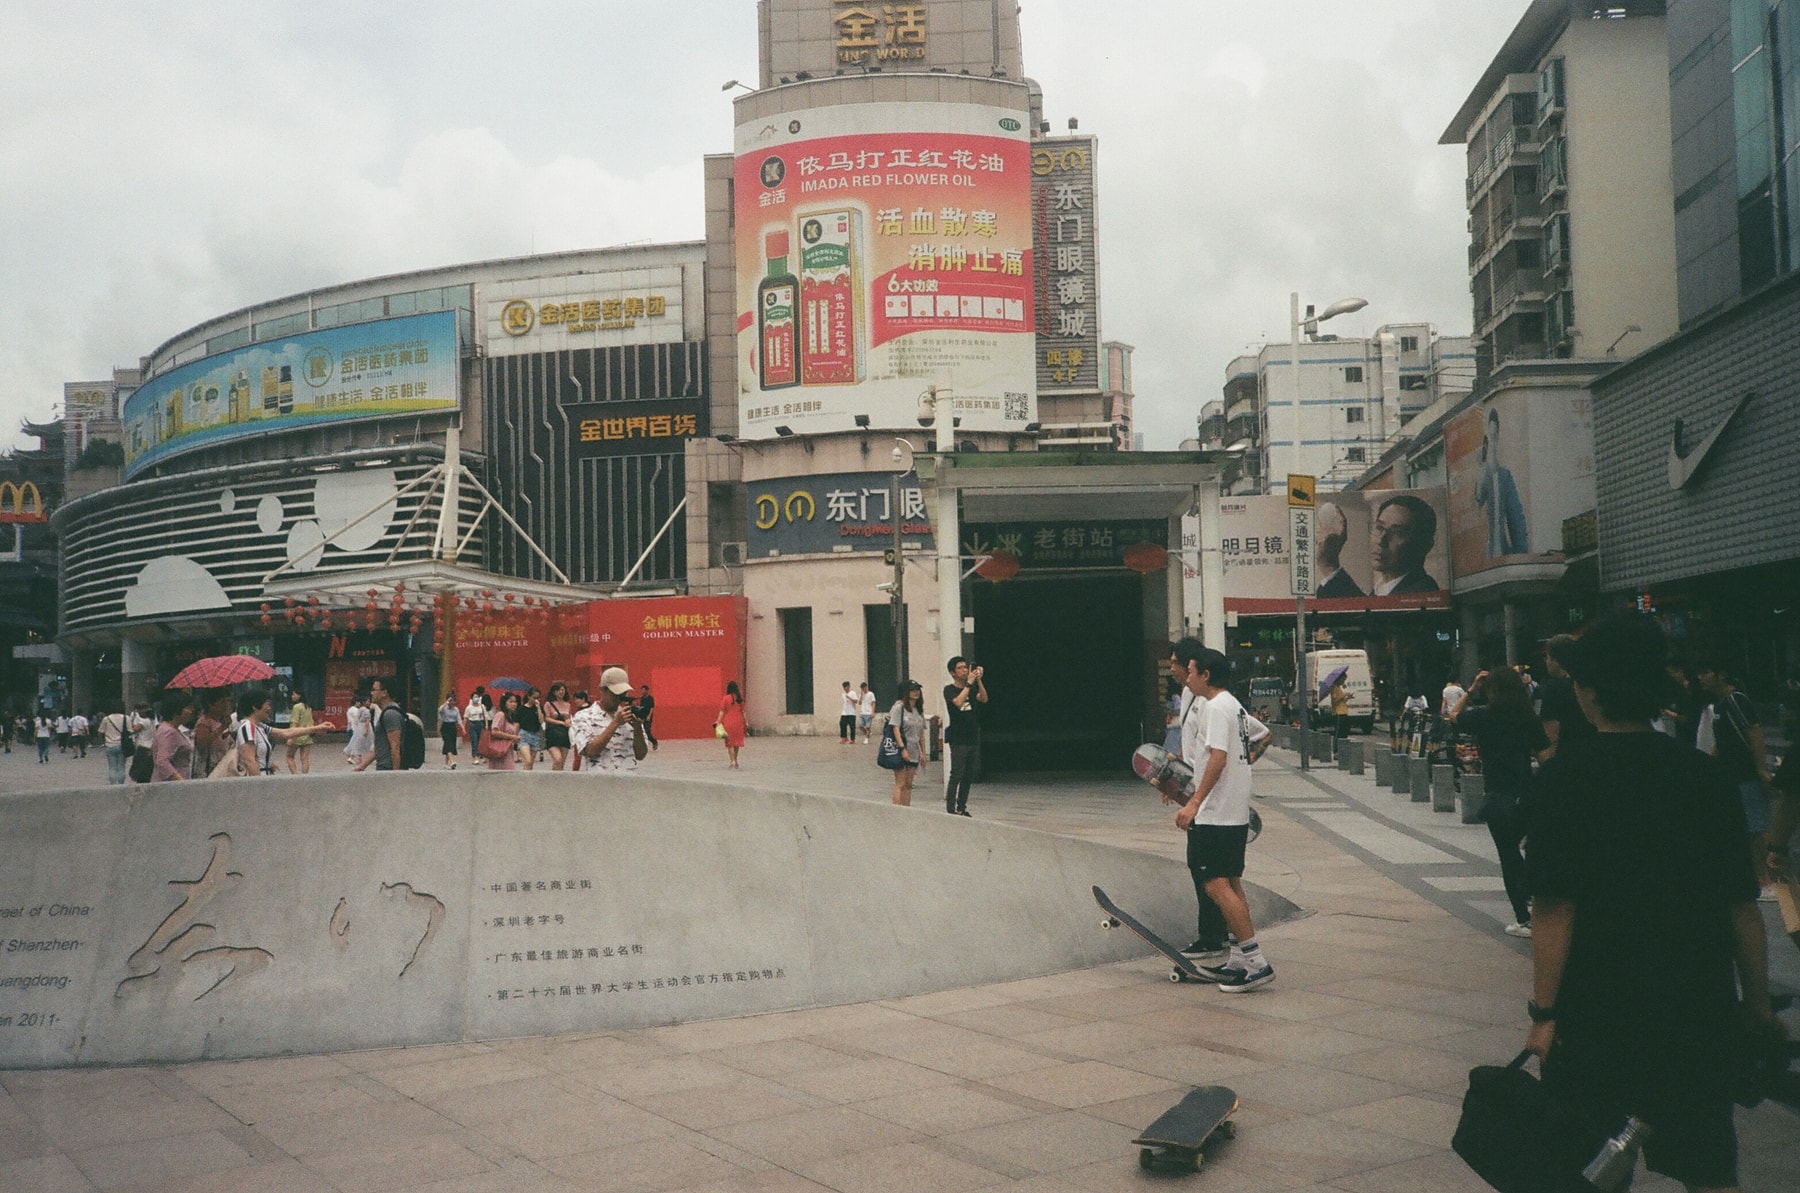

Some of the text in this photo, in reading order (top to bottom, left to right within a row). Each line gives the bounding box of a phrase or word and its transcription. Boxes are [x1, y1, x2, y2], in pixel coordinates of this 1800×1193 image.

[832, 5, 927, 47] 金活
[877, 48, 925, 60] WORD
[1000, 120, 1020, 130] OTC
[797, 149, 1004, 176] 依马打正红花油
[801, 173, 977, 193] IMADA RED FLOWER OIL
[759, 188, 786, 207] 金活
[876, 207, 998, 238] 活血散寒
[909, 243, 1024, 277] 消肿止痛
[1055, 181, 1088, 337] 东门眼镜城
[887, 273, 939, 293] 6大功效
[540, 296, 665, 325] 金活医药集团
[952, 399, 1001, 410] 活医药集团
[579, 414, 697, 442] 金世界百货
[840, 523, 932, 538] DongMe Glas
[1033, 527, 1113, 549] 老街站
[1222, 535, 1289, 555] 明月镜
[1295, 511, 1310, 592] 交通繁忙路段
[455, 639, 529, 648] GODEN MASTER
[642, 629, 725, 639] GOLDEN MASTER
[490, 879, 593, 893] 中国著名商业街
[29, 904, 45, 917] of
[49, 903, 90, 917] China
[493, 914, 566, 928] 深圳老字号
[8, 939, 80, 953] Shenzhen
[494, 943, 644, 964] 广东最佳旅游商业名街
[18, 1013, 56, 1028] 2011
